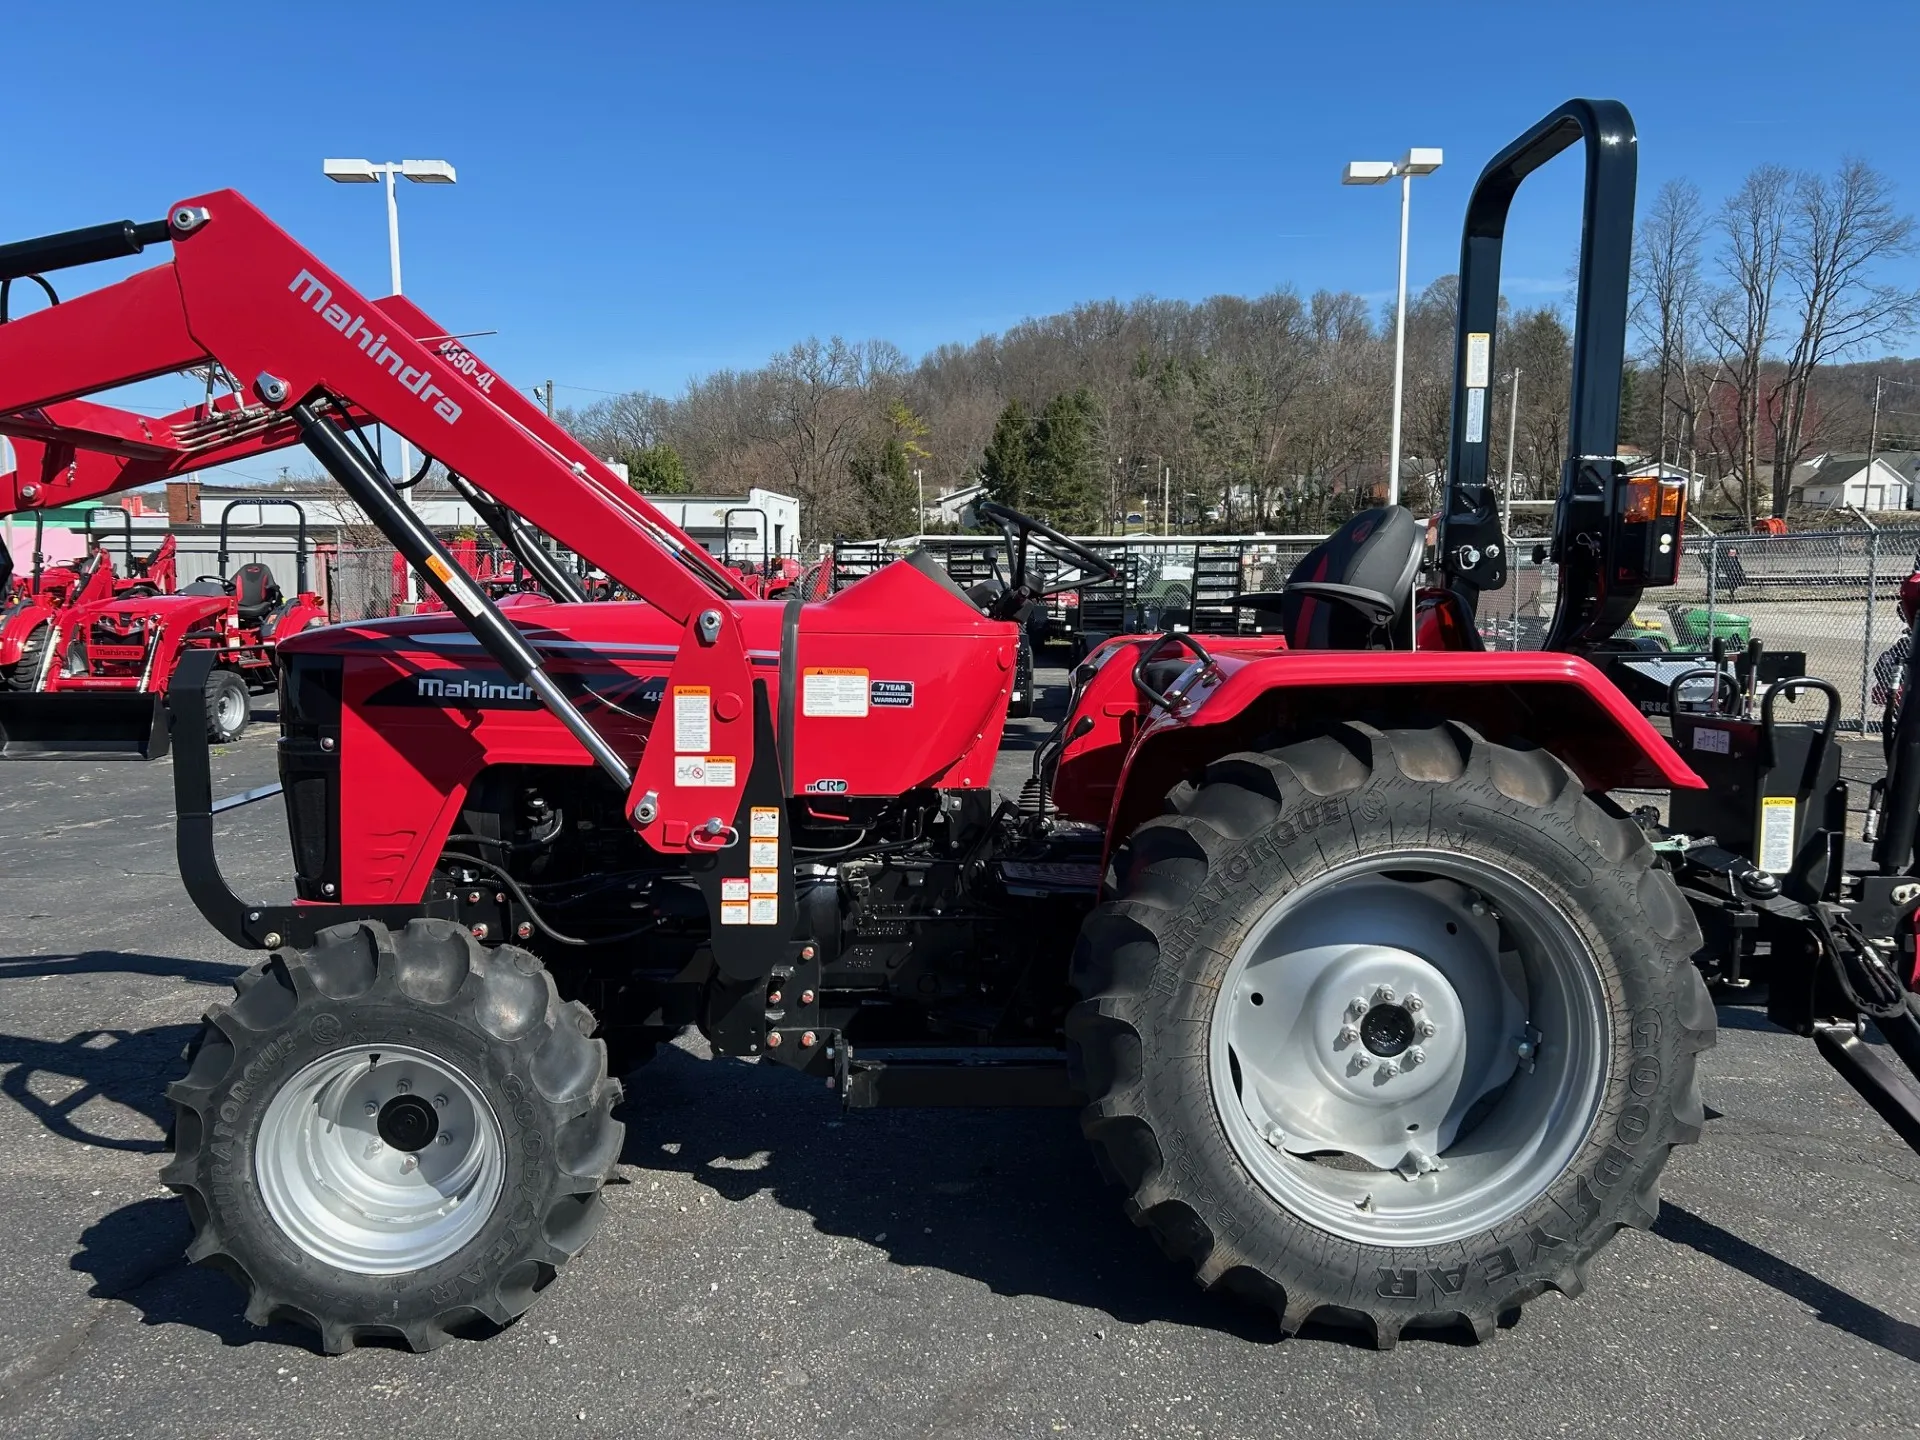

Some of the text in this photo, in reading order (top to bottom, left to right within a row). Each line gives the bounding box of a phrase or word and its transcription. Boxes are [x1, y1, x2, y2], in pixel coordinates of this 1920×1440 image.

[288, 268, 463, 425] Mahindra
[438, 340, 497, 394] 4550-4L
[418, 678, 543, 701] Mahindr
[878, 683, 885, 691] 7
[1153, 797, 1342, 997] DURATORQUE
[430, 1073, 545, 1304] GOODYEAR
[1375, 1006, 1664, 1300] GOODYEAR
